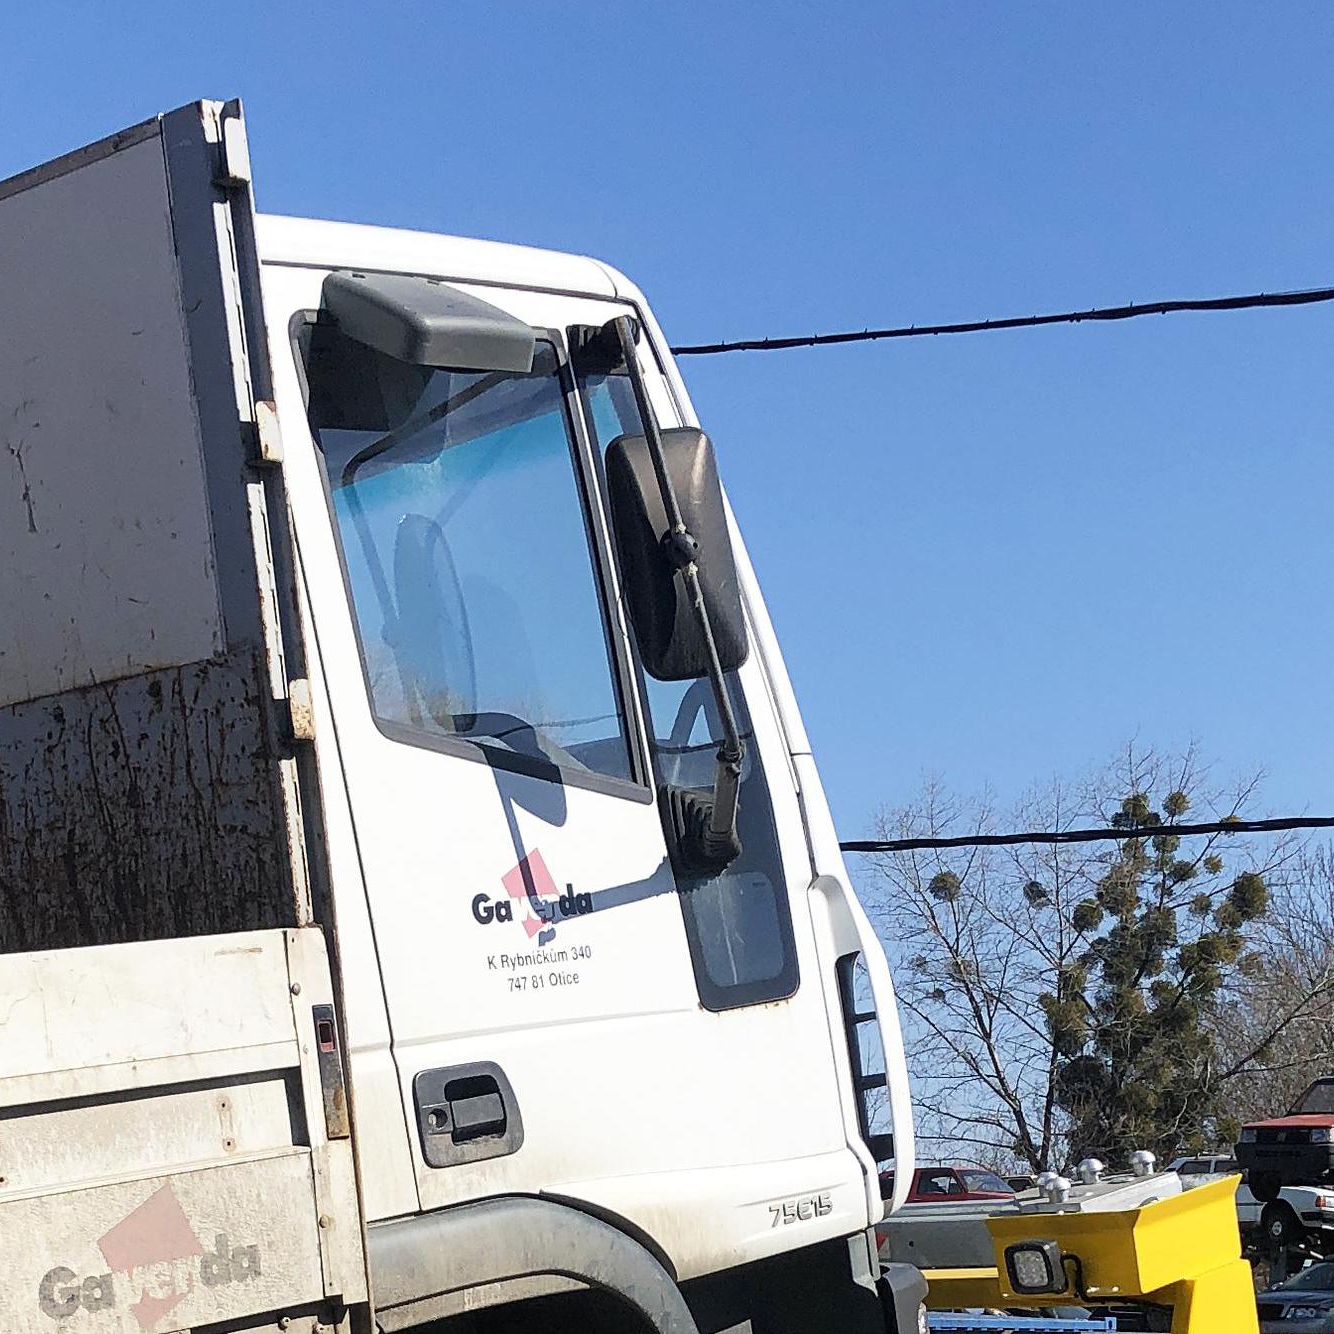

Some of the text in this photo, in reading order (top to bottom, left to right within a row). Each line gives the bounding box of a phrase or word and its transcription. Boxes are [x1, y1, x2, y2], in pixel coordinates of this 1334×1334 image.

[487, 954, 497, 971] K
[570, 945, 592, 961] 340
[507, 970, 580, 993] 747 81 Otice
[768, 1191, 833, 1228] 75E15
